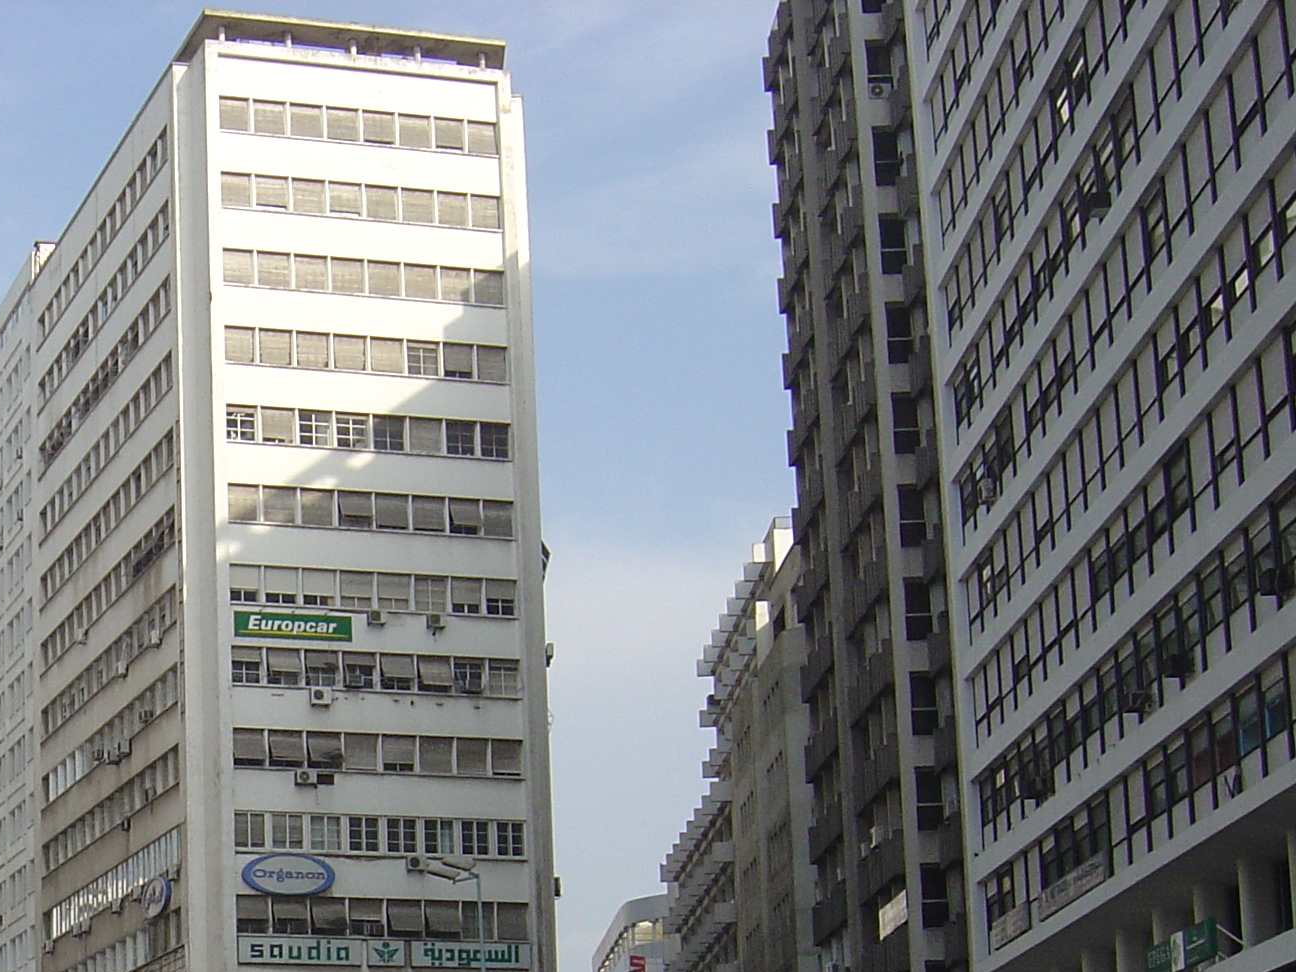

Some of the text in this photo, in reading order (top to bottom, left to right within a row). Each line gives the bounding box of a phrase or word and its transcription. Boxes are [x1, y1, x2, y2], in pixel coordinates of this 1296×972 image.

[247, 614, 338, 635] Europcar
[253, 867, 326, 883] Organon
[250, 940, 350, 962] saudia
[424, 942, 520, 967] السعودية
